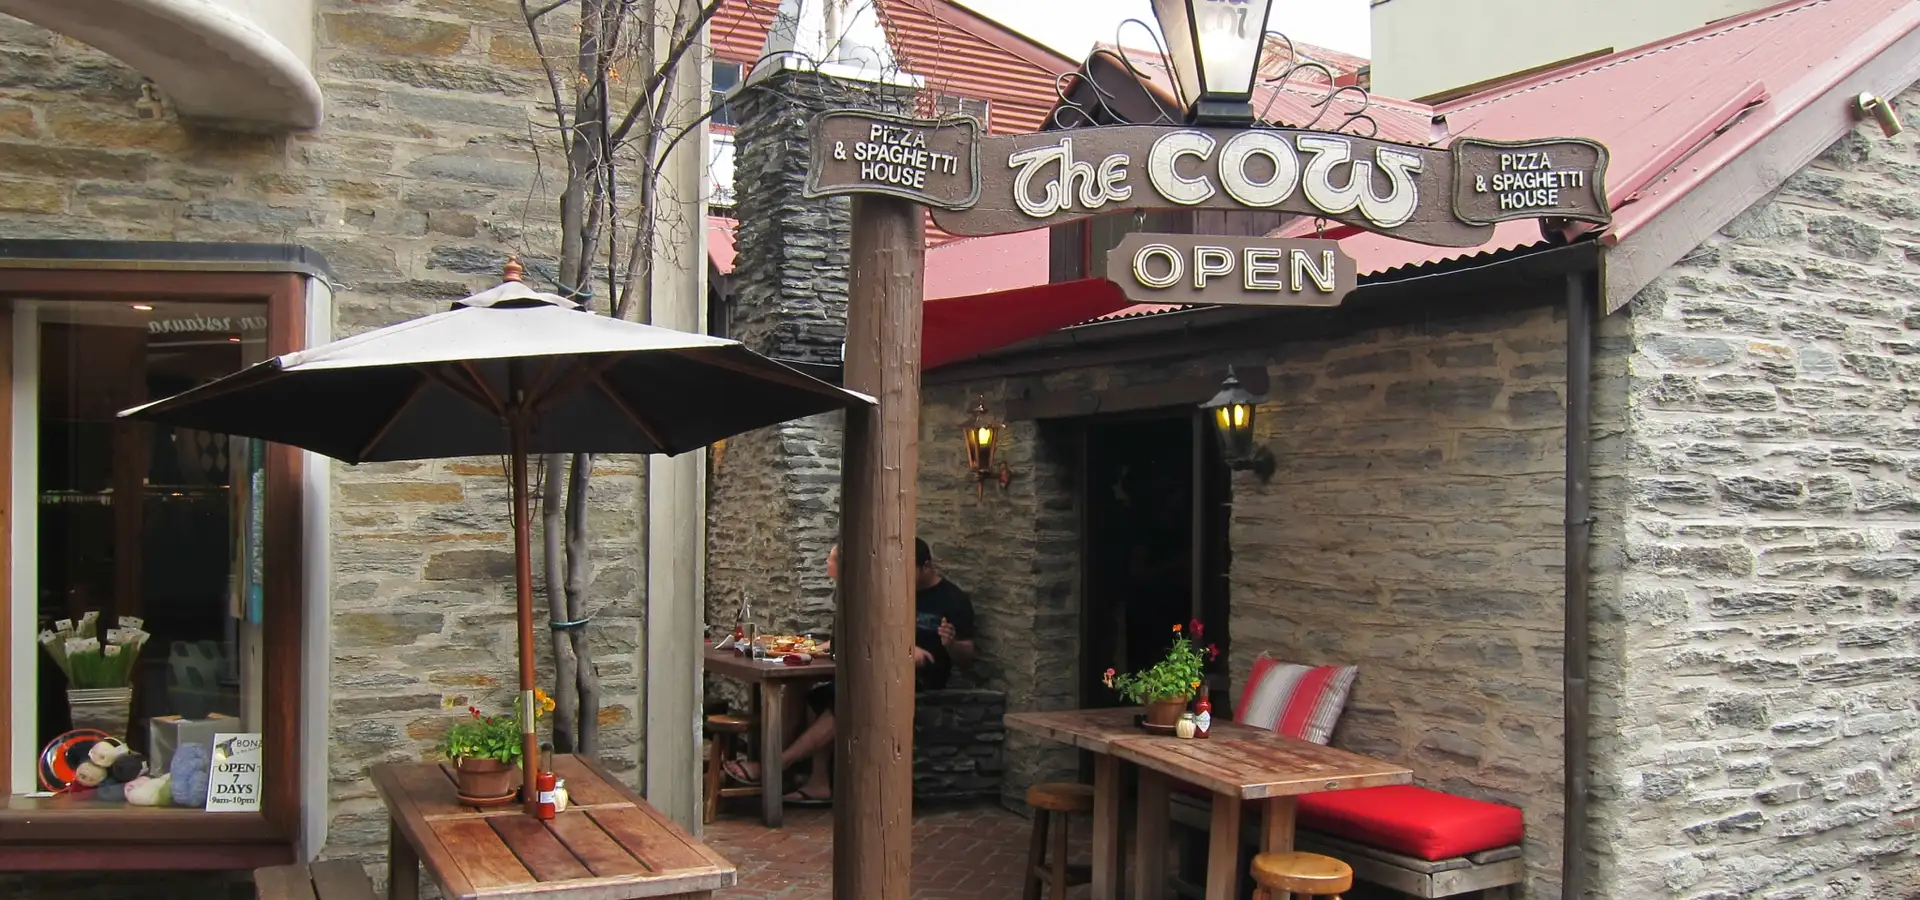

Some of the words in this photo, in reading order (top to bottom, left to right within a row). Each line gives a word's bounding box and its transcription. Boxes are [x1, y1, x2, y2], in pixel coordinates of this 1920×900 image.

[869, 123, 926, 149] PIZZA
[833, 141, 847, 161] &
[854, 142, 958, 175] SPAGHETTI
[1501, 152, 1551, 171] PIZZA
[861, 161, 926, 189] HOUSE
[1008, 136, 1132, 218] The
[1147, 130, 1424, 229] COW
[1475, 174, 1487, 192] &
[1492, 170, 1584, 191] SPAGHETTI
[1500, 189, 1559, 209] HOUSE
[1132, 243, 1336, 292] OPEN
[218, 763, 256, 773] OPEN
[232, 773, 240, 784] 7
[216, 784, 253, 794] DAYS
[211, 796, 256, 805] 9am-10pm
